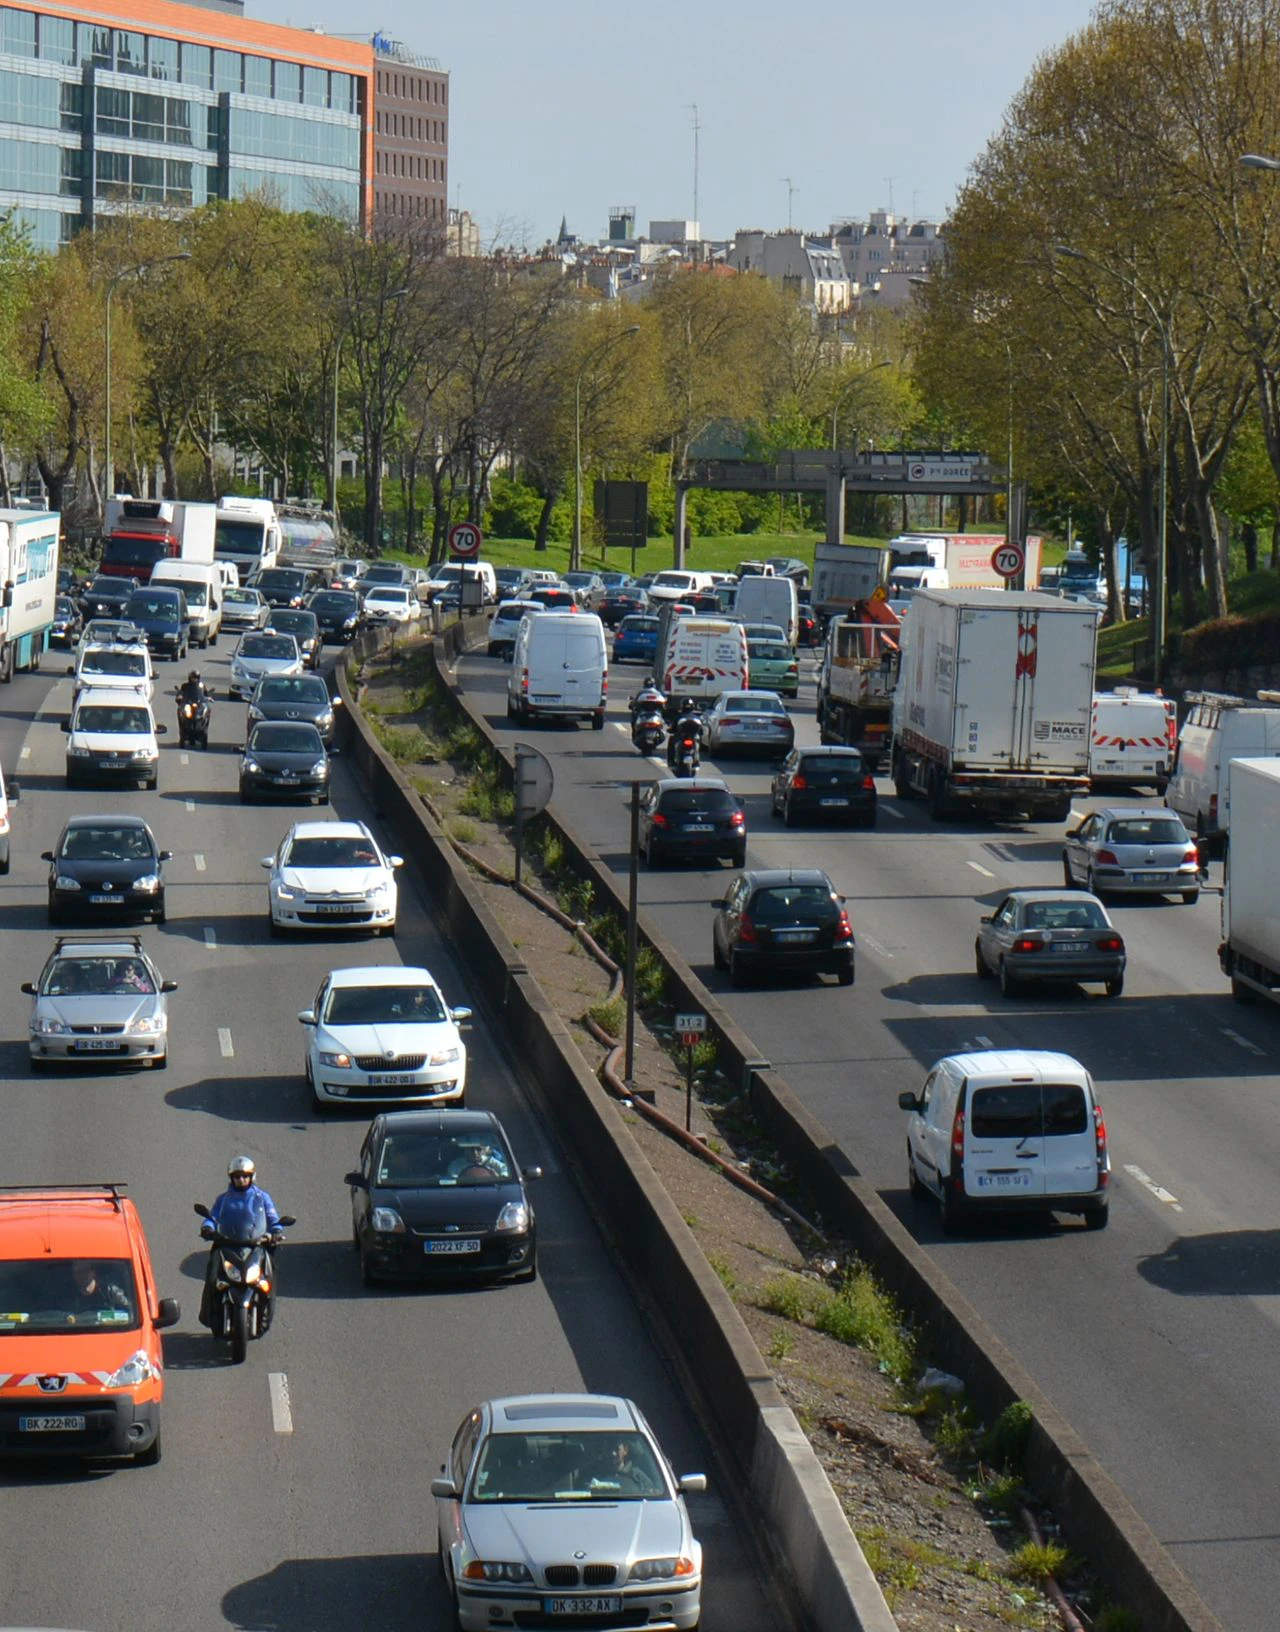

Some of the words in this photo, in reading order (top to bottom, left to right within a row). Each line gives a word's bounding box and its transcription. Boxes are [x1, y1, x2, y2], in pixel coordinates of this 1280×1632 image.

[456, 532, 475, 546] 70
[999, 553, 1018, 568] 70
[431, 1242, 452, 1252] 2022
[467, 1240, 478, 1251] 50
